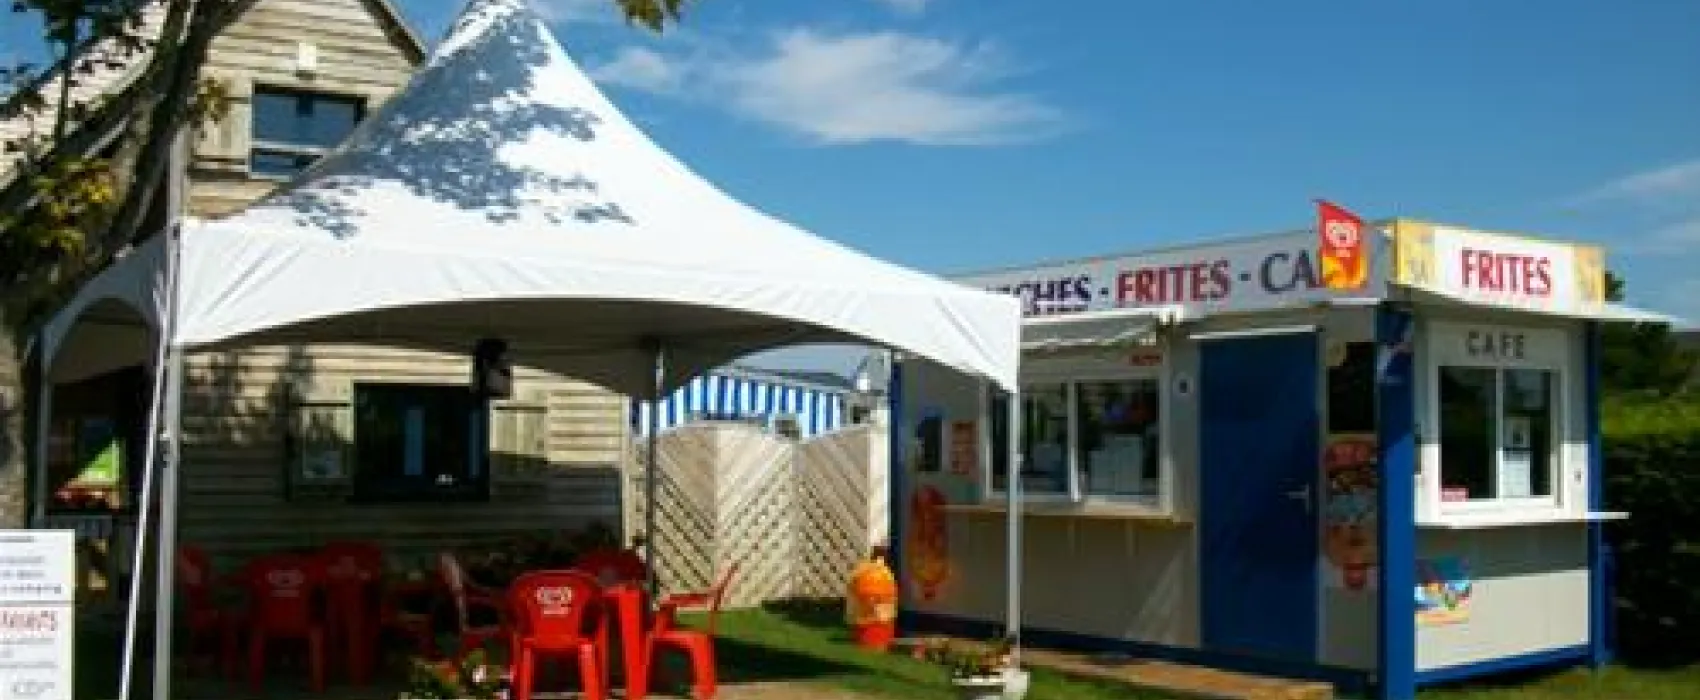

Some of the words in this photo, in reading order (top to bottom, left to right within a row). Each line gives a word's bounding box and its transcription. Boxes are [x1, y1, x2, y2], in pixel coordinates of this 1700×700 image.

[1116, 260, 1231, 305] FRITES
[1260, 250, 1324, 294] CA
[1461, 248, 1551, 295] FRITES
